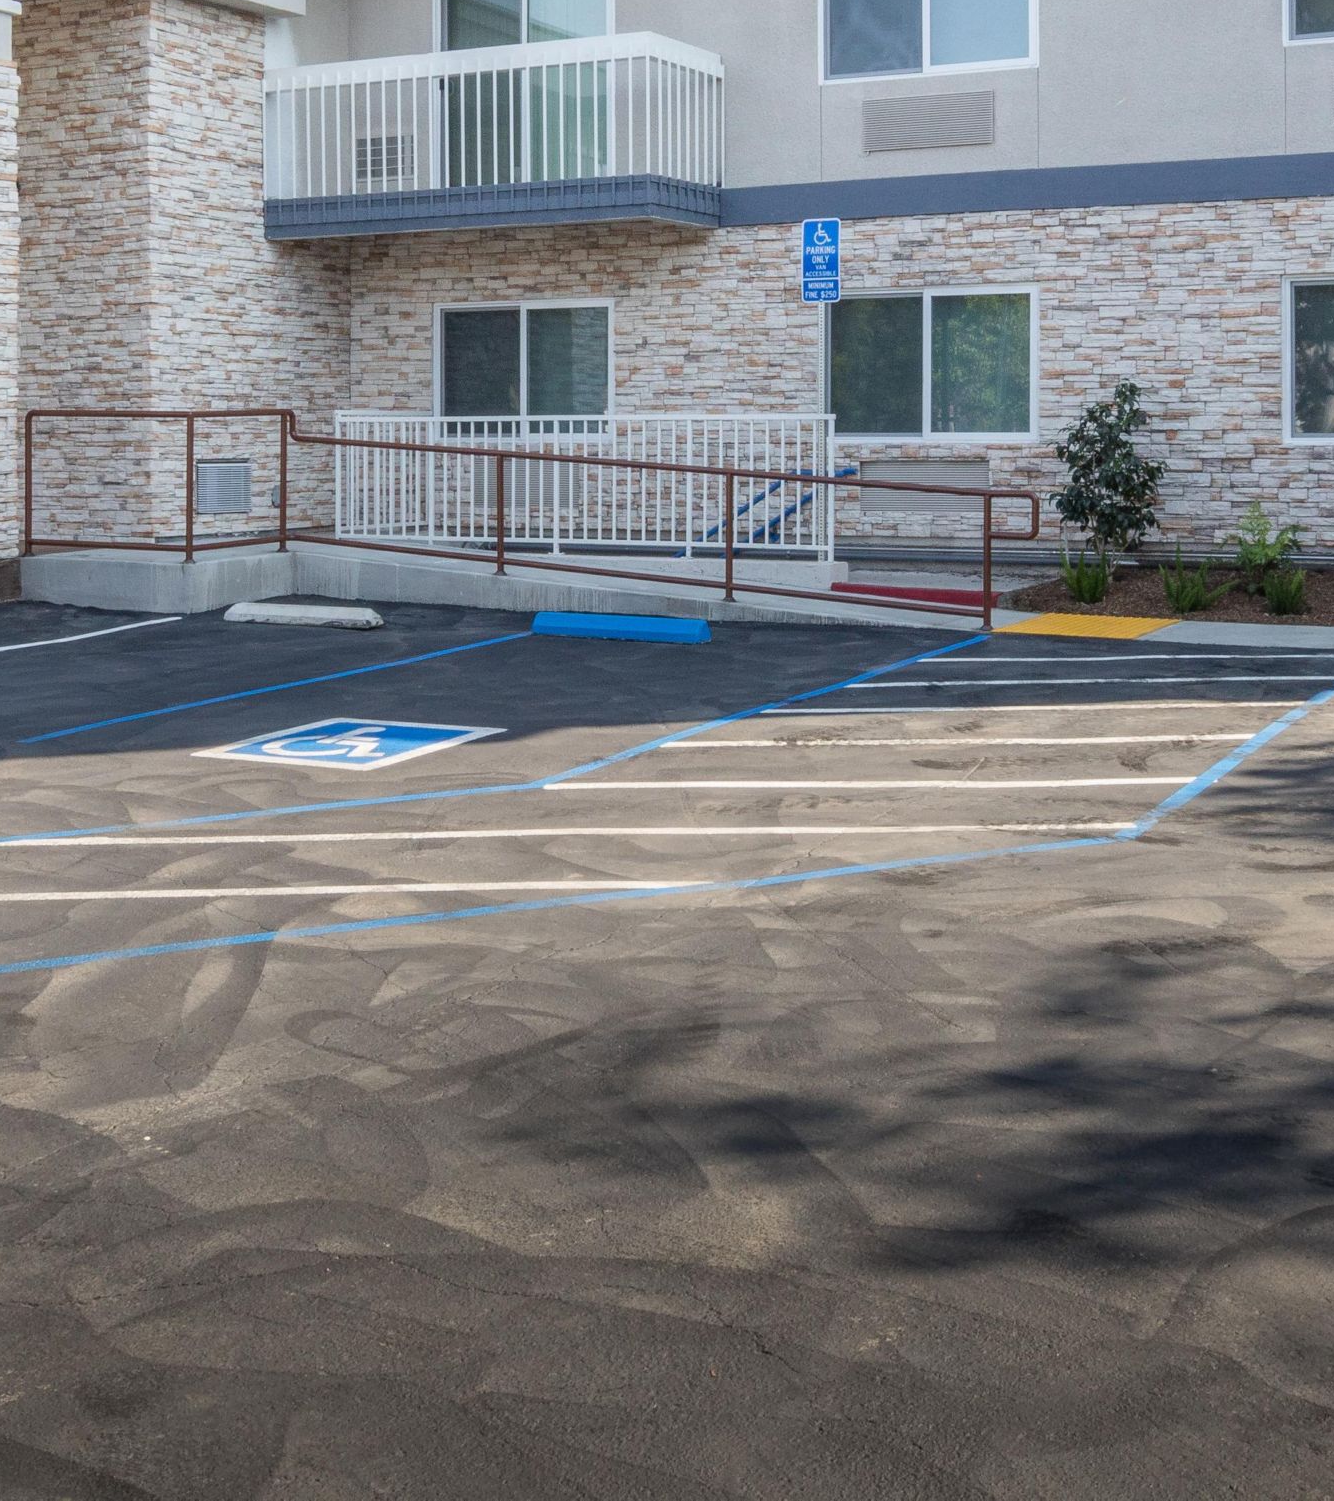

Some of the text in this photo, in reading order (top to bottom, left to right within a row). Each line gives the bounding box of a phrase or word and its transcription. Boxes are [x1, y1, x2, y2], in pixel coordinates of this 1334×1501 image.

[805, 246, 836, 255] PARKING
[811, 255, 830, 264] ONLY
[805, 290, 837, 299] FINE $250
